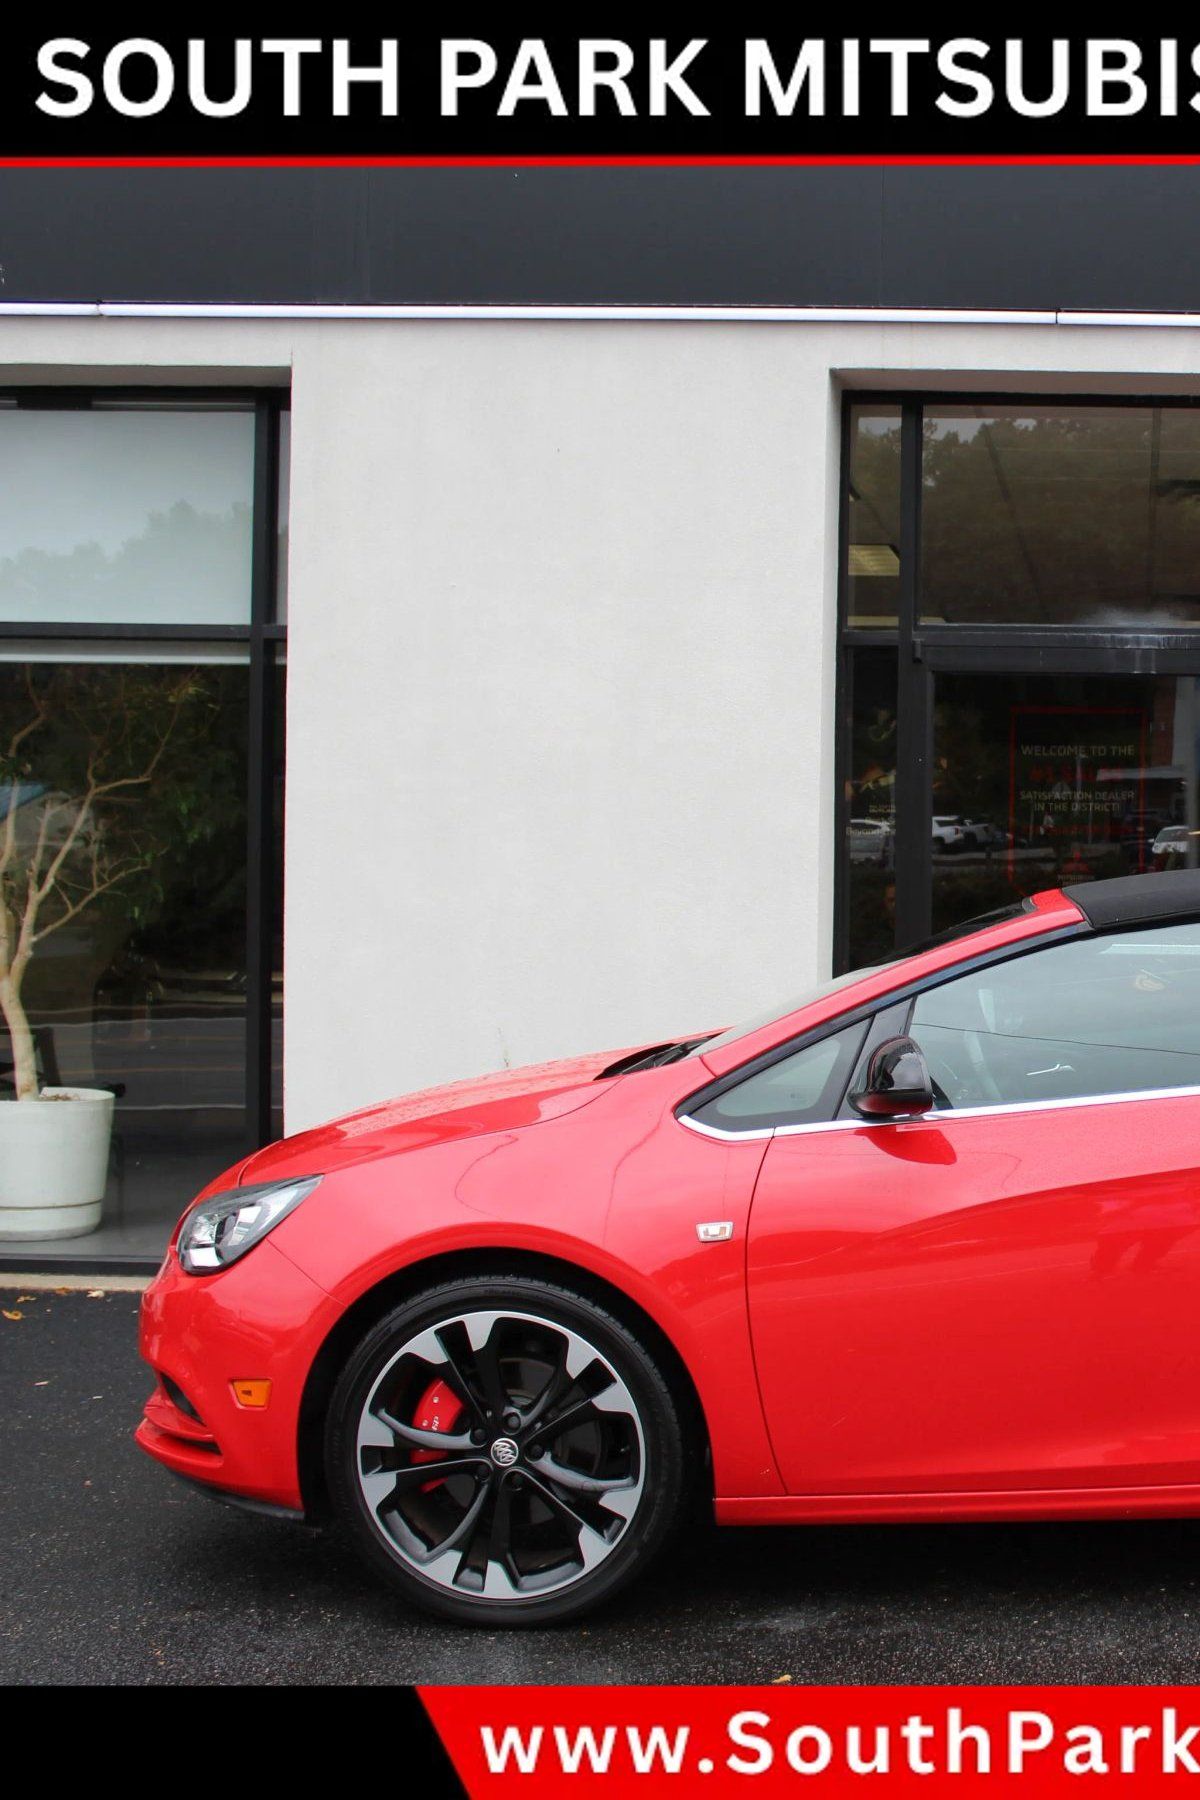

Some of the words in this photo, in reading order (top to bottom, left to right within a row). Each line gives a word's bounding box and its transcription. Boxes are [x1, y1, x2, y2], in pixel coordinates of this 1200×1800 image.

[1020, 744, 1087, 757] WELCOME
[1091, 745, 1107, 757] TO
[1110, 744, 1135, 757] THE
[1019, 790, 1092, 801] SATISFACTION
[1095, 790, 1135, 801] DEALER
[1034, 802, 1045, 812] IN
[1048, 802, 1069, 812] THE
